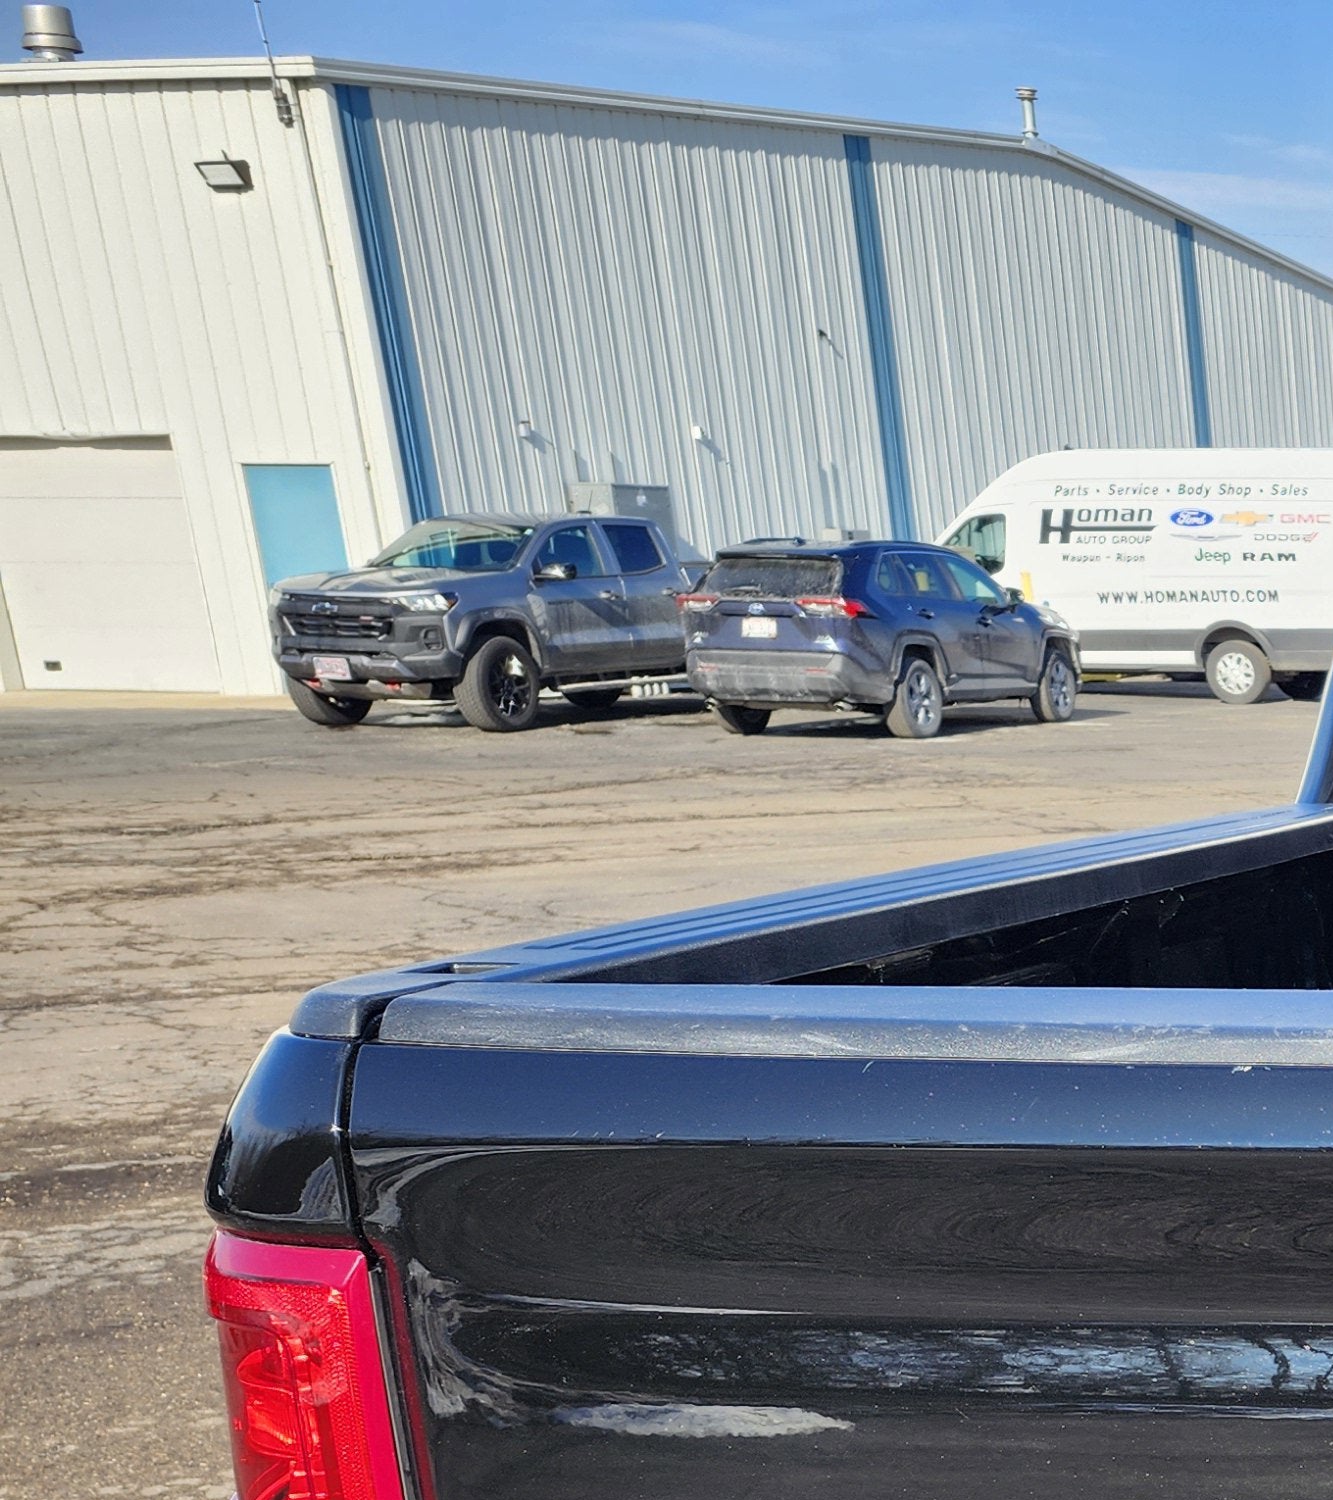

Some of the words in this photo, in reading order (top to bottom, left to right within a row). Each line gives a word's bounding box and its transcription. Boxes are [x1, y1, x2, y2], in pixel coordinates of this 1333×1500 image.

[1053, 484, 1090, 497] Parts
[1107, 482, 1160, 497] Service
[1177, 483, 1212, 498] Body
[1218, 483, 1252, 498] Shop
[1270, 483, 1310, 497] Sales
[1176, 509, 1209, 526] Ford
[1279, 513, 1332, 524] GMC
[1039, 508, 1153, 544] Homan
[1075, 535, 1107, 544] AUTO
[1111, 535, 1153, 544] GROUP
[1194, 548, 1232, 565] Jeep
[1241, 552, 1297, 562] RAM
[1096, 589, 1280, 604] WWW.HOMANAUTO.COM
